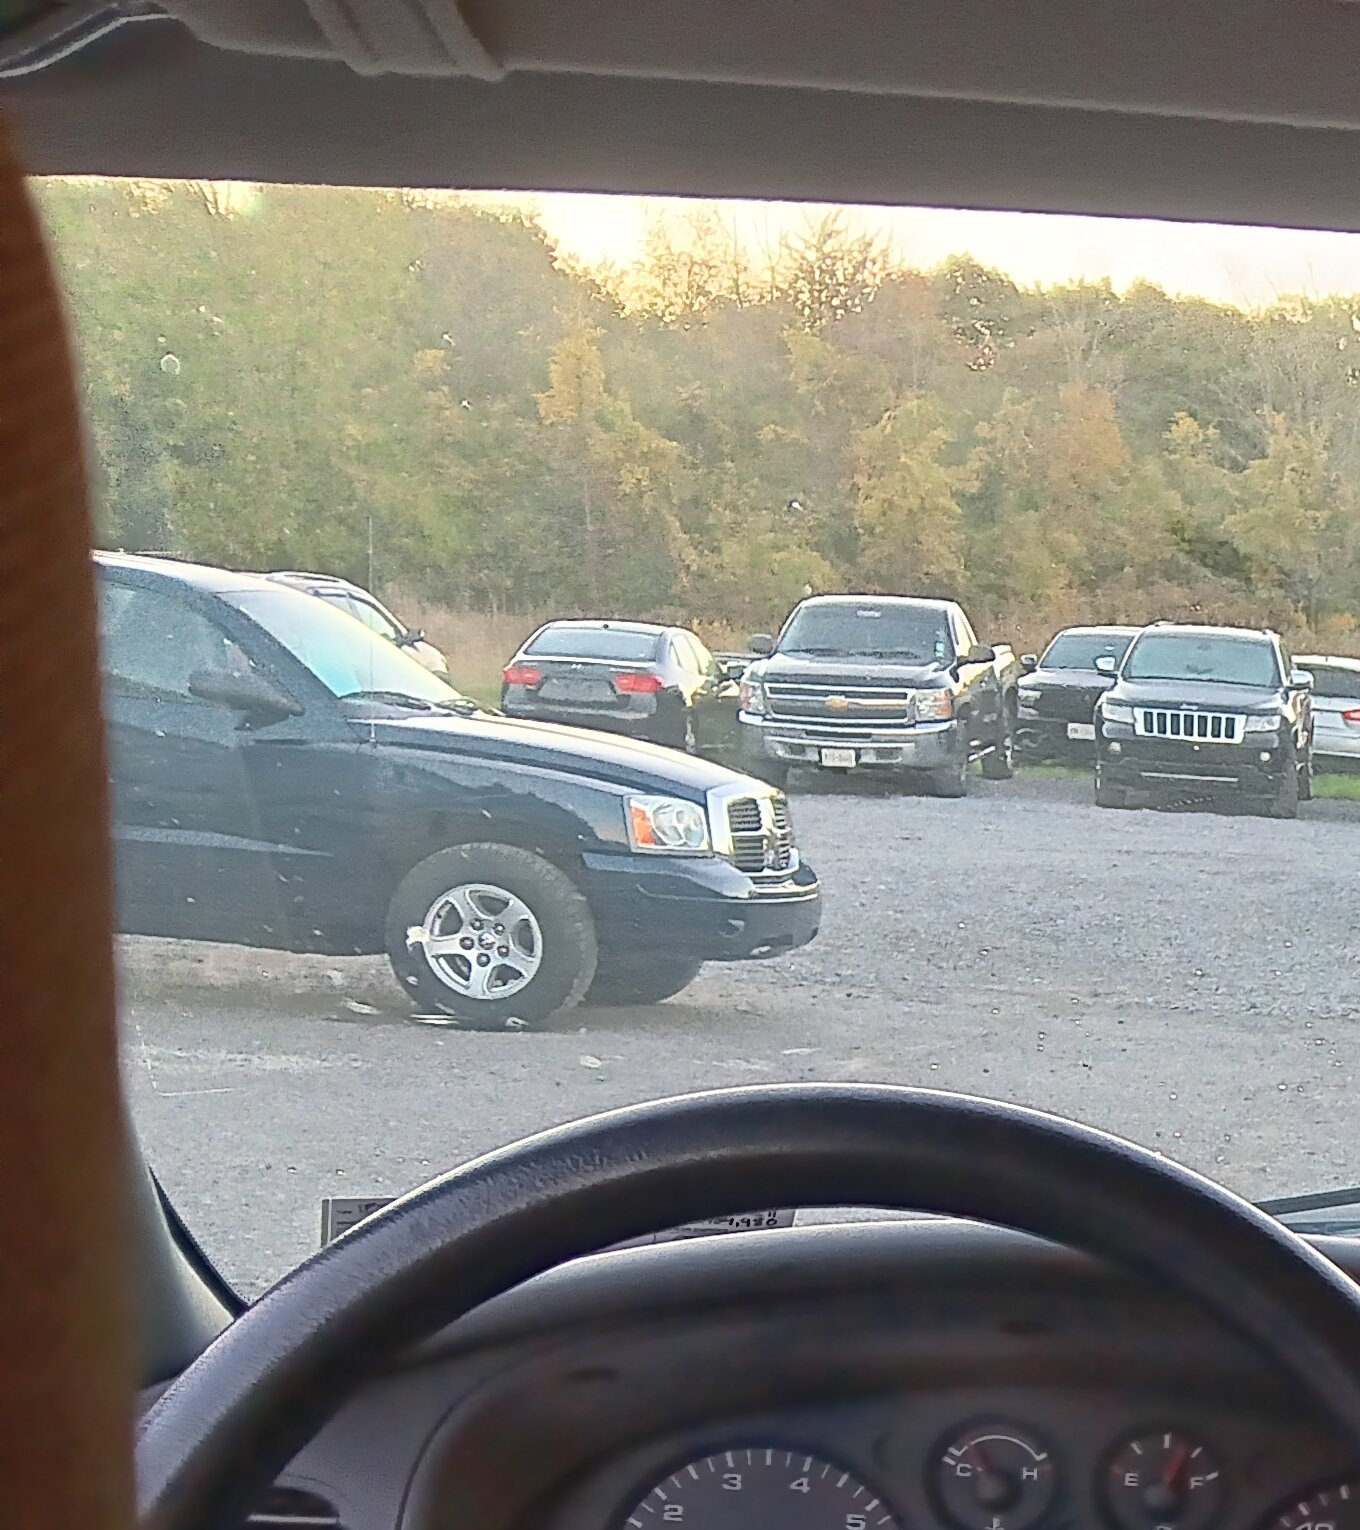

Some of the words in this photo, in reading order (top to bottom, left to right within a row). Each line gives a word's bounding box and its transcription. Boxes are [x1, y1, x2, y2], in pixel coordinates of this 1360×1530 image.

[956, 1463, 972, 1477] C
[1022, 1467, 1038, 1481] H
[722, 1473, 742, 1491] 3
[790, 1477, 810, 1494] 4
[1124, 1473, 1138, 1487] E
[1190, 1477, 1204, 1490] F
[663, 1504, 683, 1522] 2
[845, 1513, 866, 1530] 5
